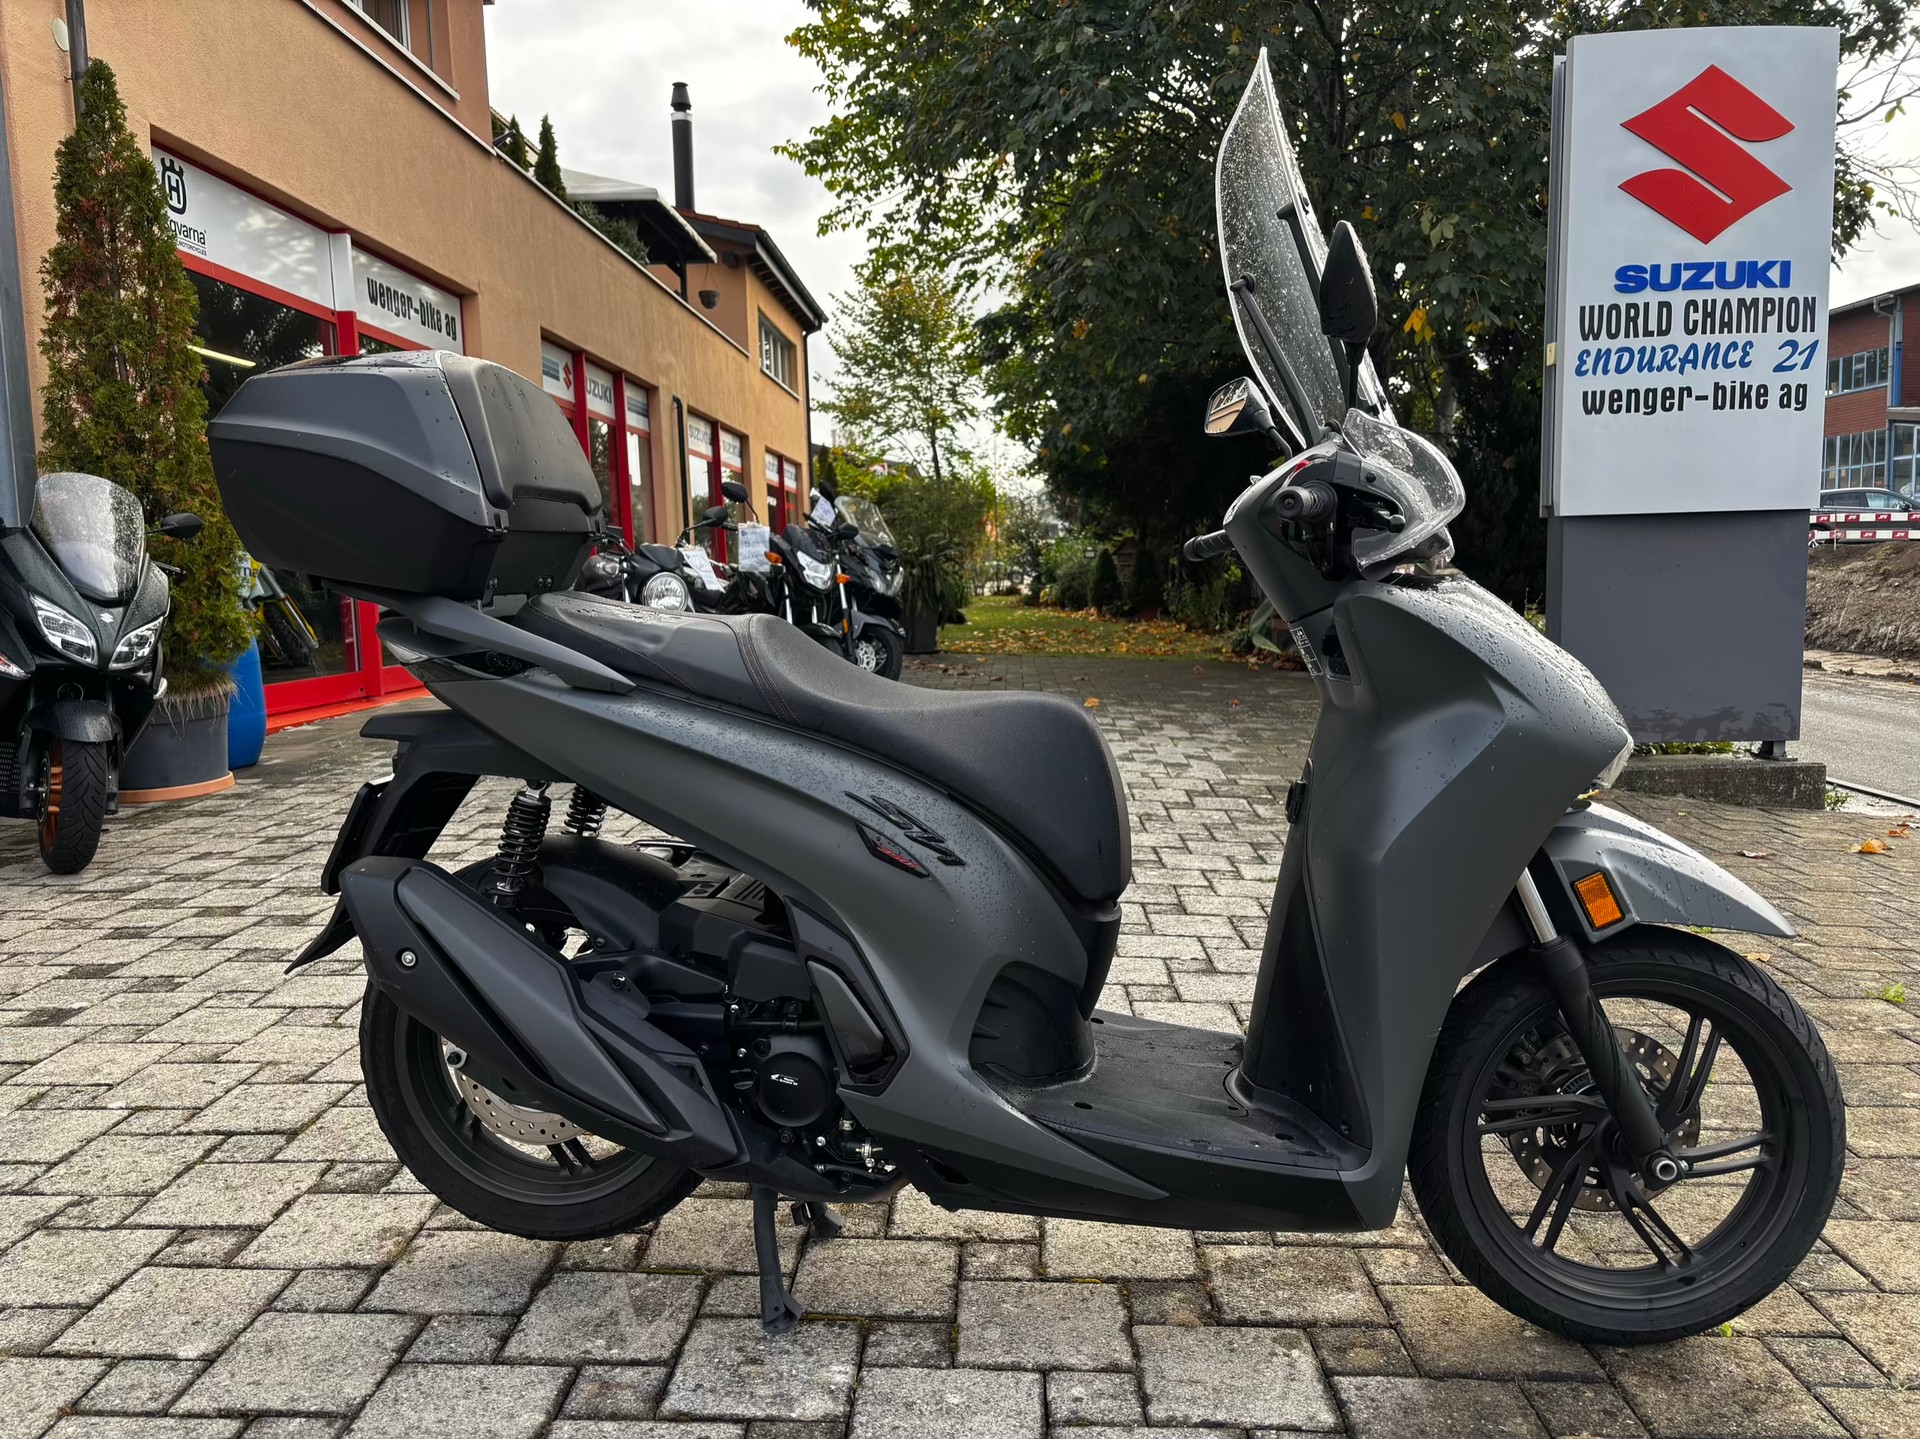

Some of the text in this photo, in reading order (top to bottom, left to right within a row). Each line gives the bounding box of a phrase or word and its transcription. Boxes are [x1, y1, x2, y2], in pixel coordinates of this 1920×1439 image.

[169, 219, 206, 246] qvarna
[1614, 260, 1791, 293] SUZUKI
[366, 276, 457, 342] wenger-bike ag
[1579, 296, 1817, 342] WORLD CHAMPION
[1574, 339, 1820, 378] ENDURANCE 21
[585, 376, 613, 405] UZUKI
[1582, 380, 1808, 416] wenger-bike ag
